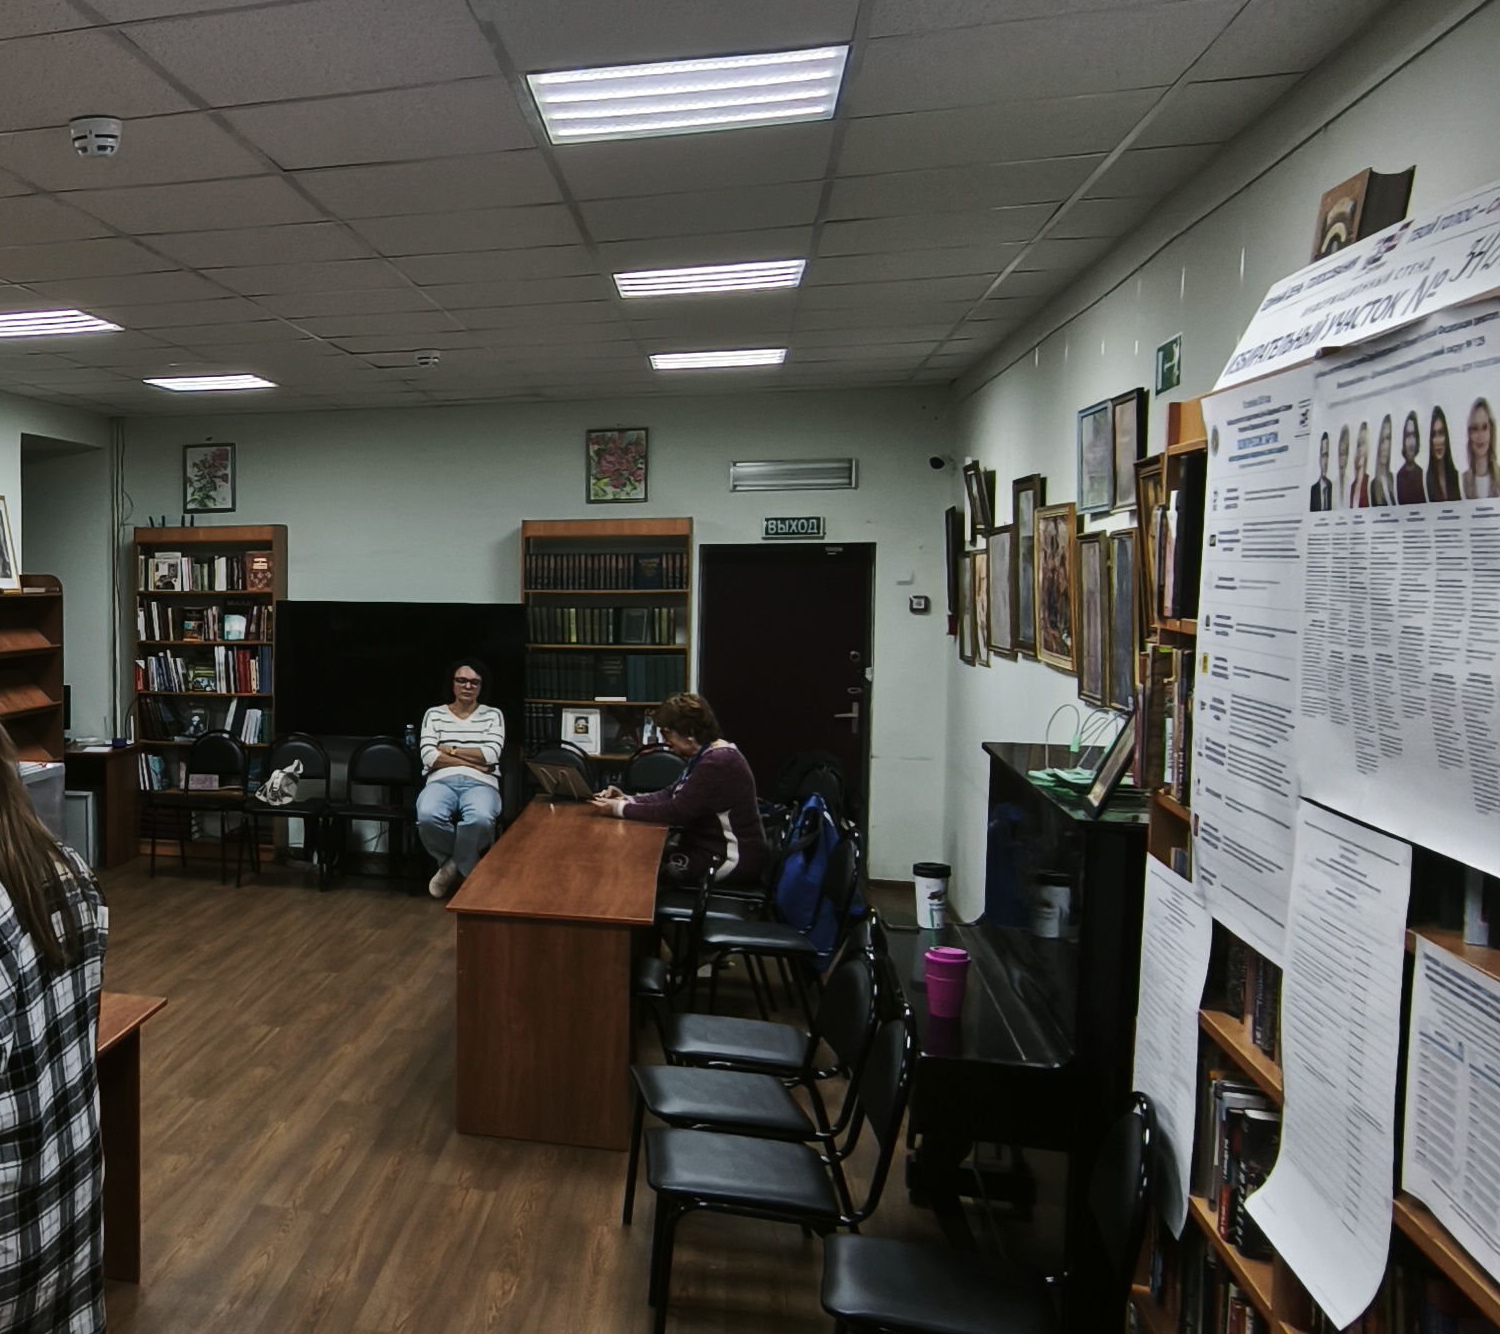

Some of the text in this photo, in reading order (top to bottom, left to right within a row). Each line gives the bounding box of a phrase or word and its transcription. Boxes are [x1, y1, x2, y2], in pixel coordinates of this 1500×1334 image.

[1393, 256, 1436, 282] СТЕНД
[1224, 313, 1331, 377] ИЗБИРАТЕЛЬНЫЙ
[1320, 288, 1409, 342] УЧАСТОК
[1400, 268, 1450, 317] №
[767, 519, 819, 534] ВЫХОД
